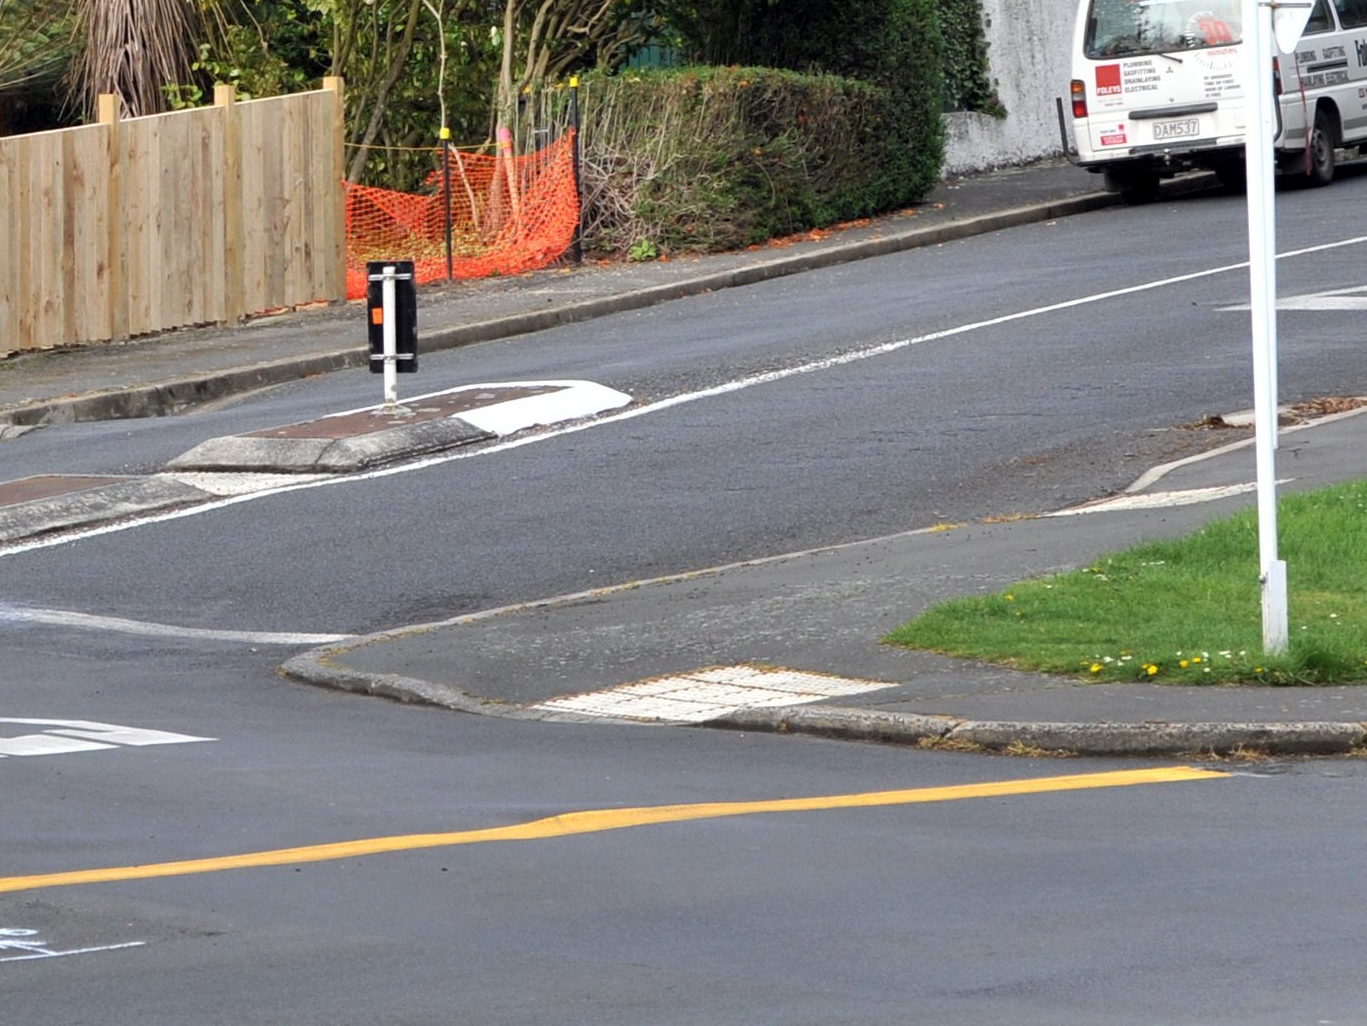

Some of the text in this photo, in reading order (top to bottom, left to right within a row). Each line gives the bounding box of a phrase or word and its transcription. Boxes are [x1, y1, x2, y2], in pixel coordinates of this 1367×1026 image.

[1097, 84, 1121, 94] FOLEYS
[1124, 85, 1158, 93] ELECTRICAL
[1154, 121, 1197, 137] DAM537
